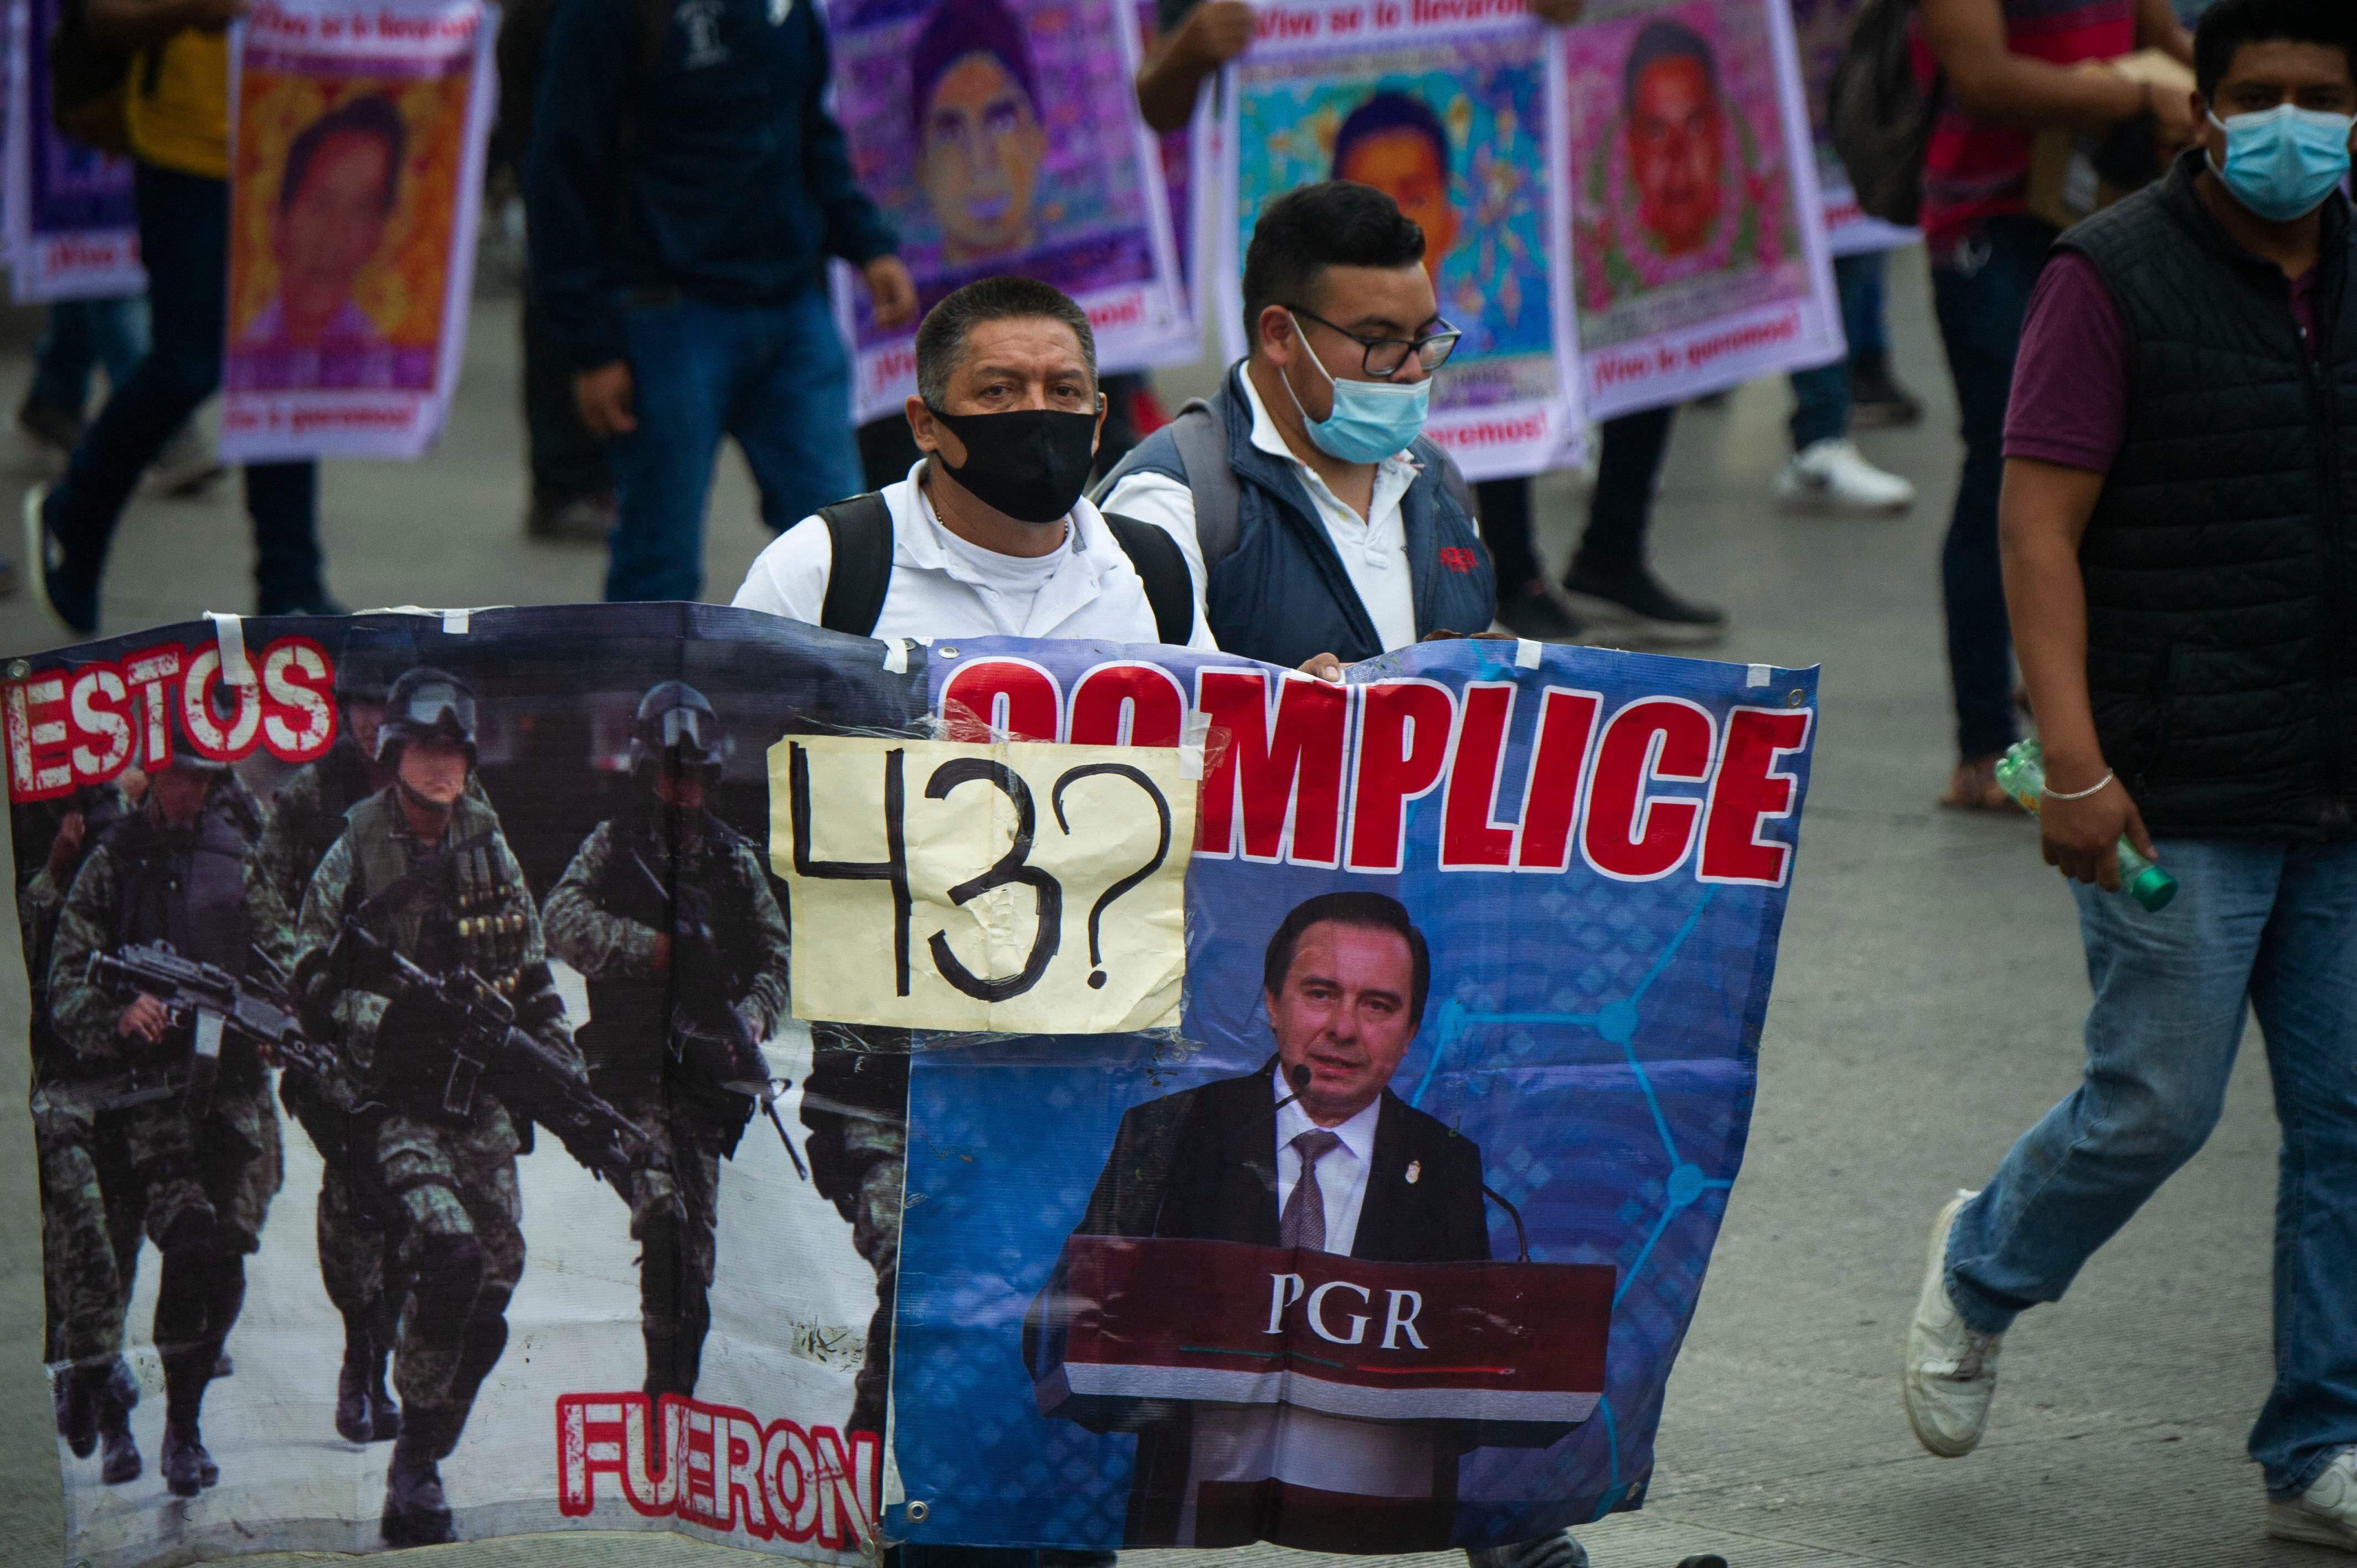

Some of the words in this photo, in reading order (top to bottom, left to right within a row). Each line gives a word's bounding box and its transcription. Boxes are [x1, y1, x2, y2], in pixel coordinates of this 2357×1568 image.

[2, 636, 336, 803] ESTOS
[789, 741, 1170, 1003] 43?
[1262, 1273, 1429, 1349] PGR
[555, 1391, 881, 1550] FUERON
